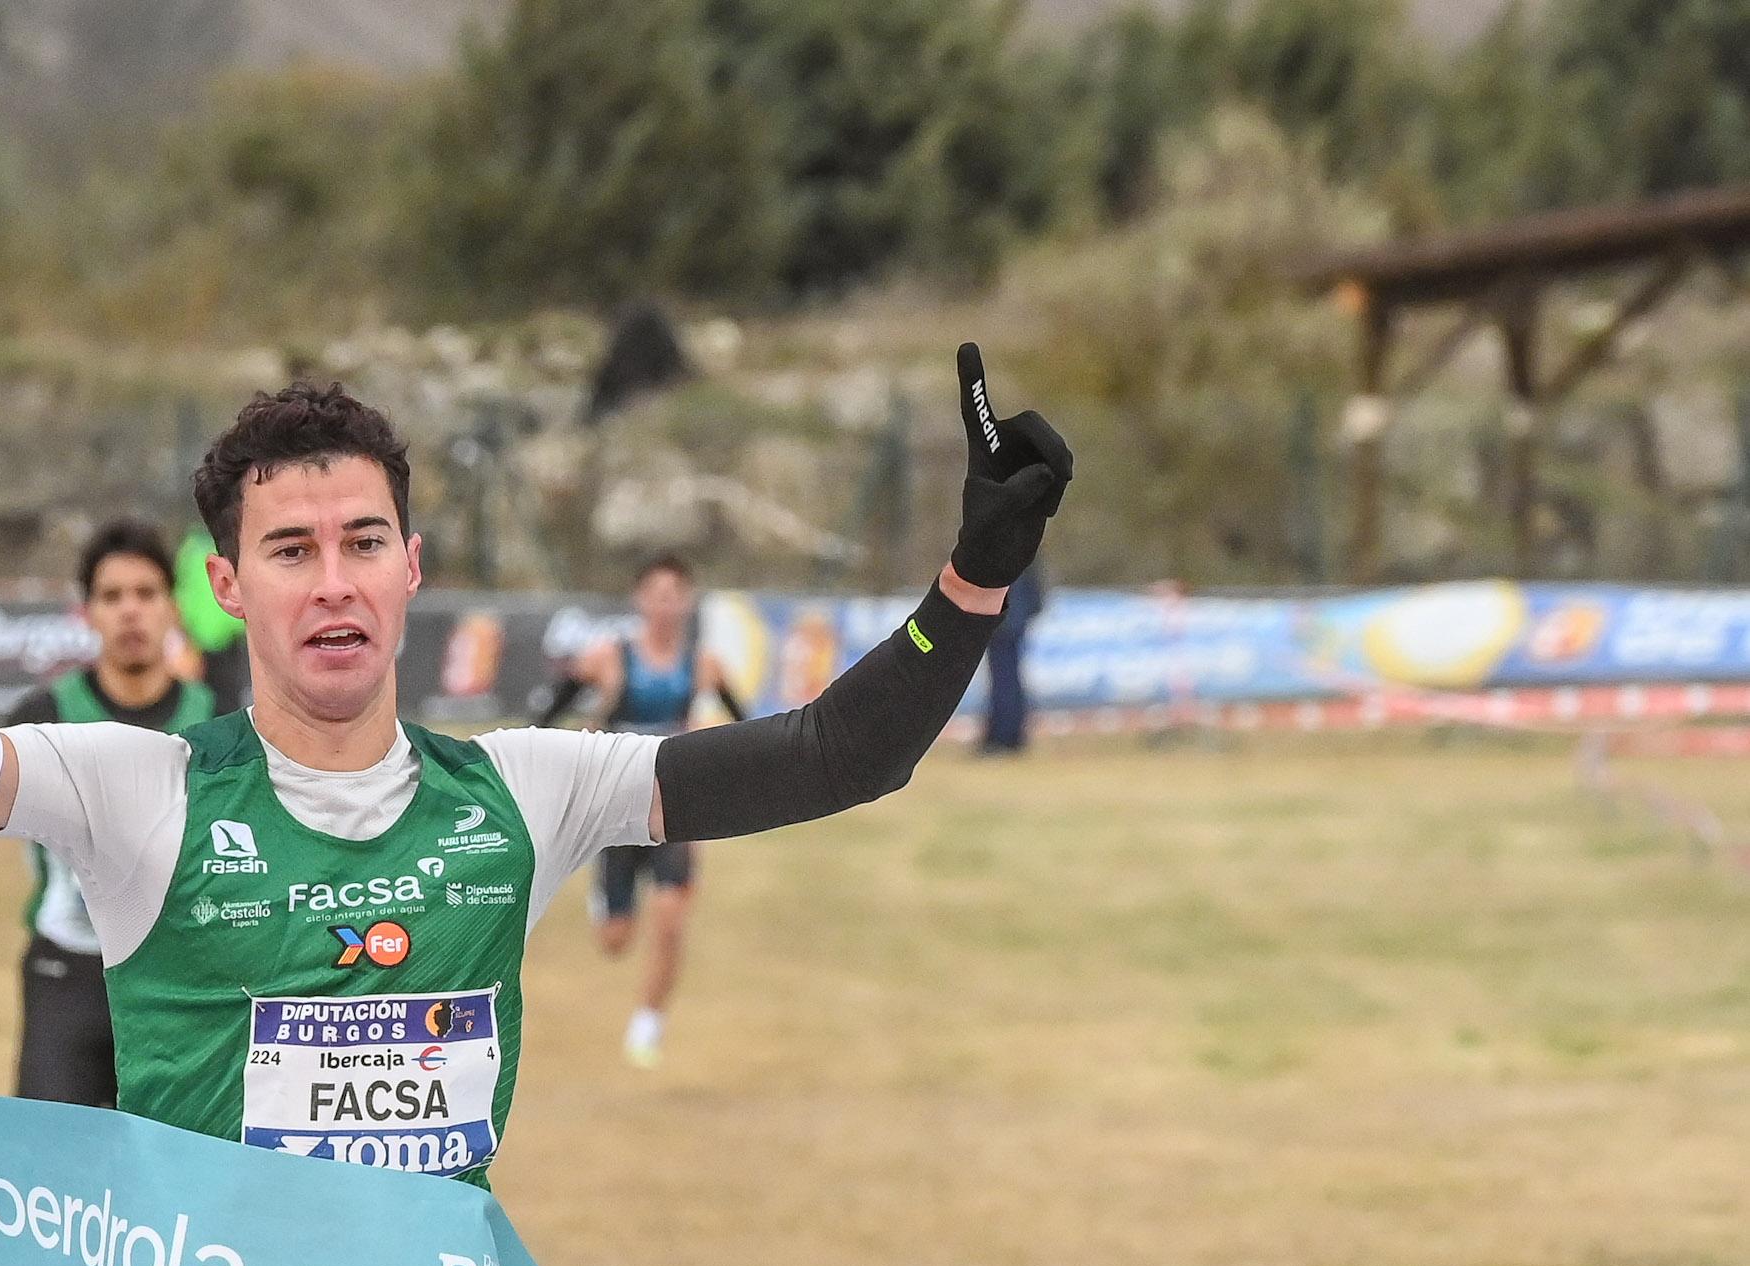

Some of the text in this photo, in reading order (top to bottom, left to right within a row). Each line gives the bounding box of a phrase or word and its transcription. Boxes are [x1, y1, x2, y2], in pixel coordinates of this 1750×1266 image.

[971, 379, 1000, 454] KIPRUN
[202, 857, 268, 875] rasán
[288, 876, 425, 912] Facsa
[466, 884, 514, 896] Diputació
[467, 895, 480, 904] de
[221, 904, 271, 920] Castelló
[306, 904, 426, 923] ciclo integral del agua
[370, 935, 404, 954] Fer
[282, 1000, 407, 1022] DIPUTACIÓN
[276, 1023, 406, 1043] BURGOS
[250, 1046, 495, 1071] 224 Ibercaja 4
[310, 1079, 449, 1122] FACSA
